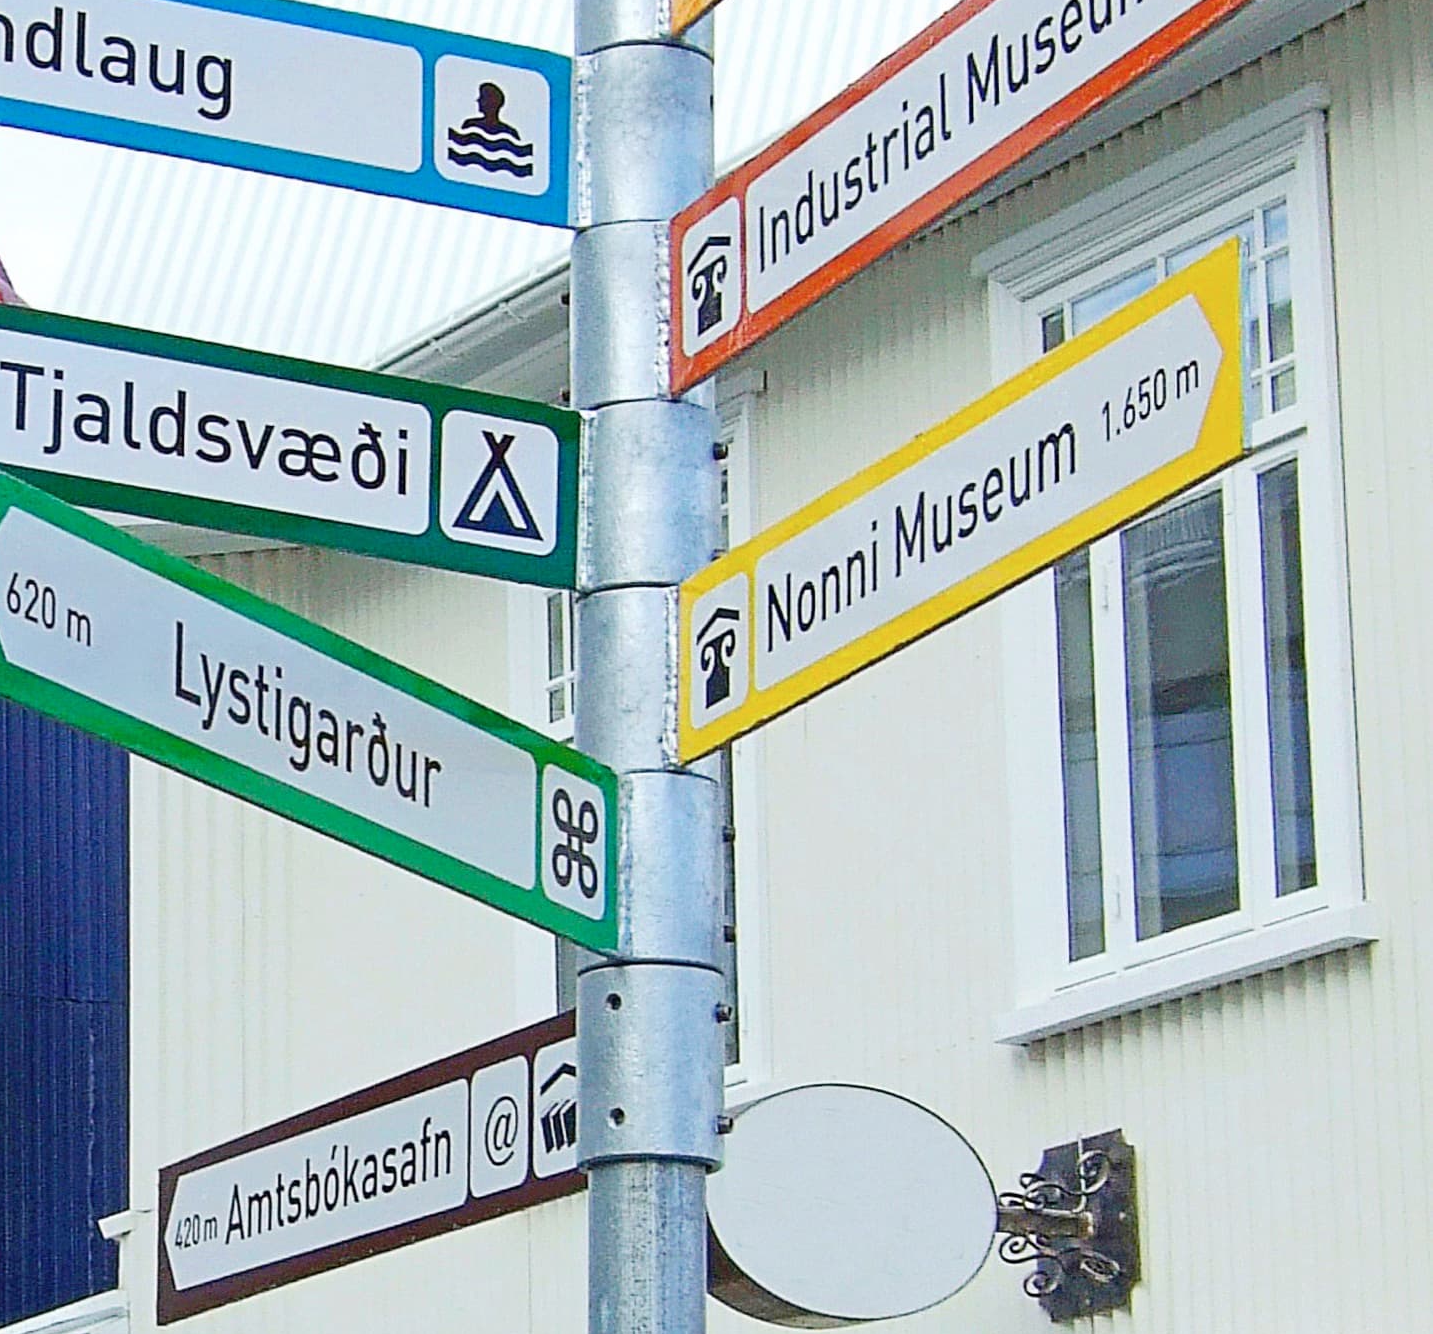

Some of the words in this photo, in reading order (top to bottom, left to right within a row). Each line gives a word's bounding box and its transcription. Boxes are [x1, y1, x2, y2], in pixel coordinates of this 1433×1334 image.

[759, 72, 952, 274] Industrial
[0, 360, 408, 496] Tjaldsvæði
[767, 520, 878, 653] Nonni
[895, 422, 1076, 578] Museum
[1101, 368, 1167, 442] 1.650
[1176, 360, 1199, 400] m
[6, 572, 56, 630] 620
[66, 608, 91, 647] m
[175, 621, 442, 808] Lystigarður
[174, 1213, 201, 1249] 420
[203, 1216, 218, 1242] m
[225, 1116, 451, 1245] Amtsbókasafn
